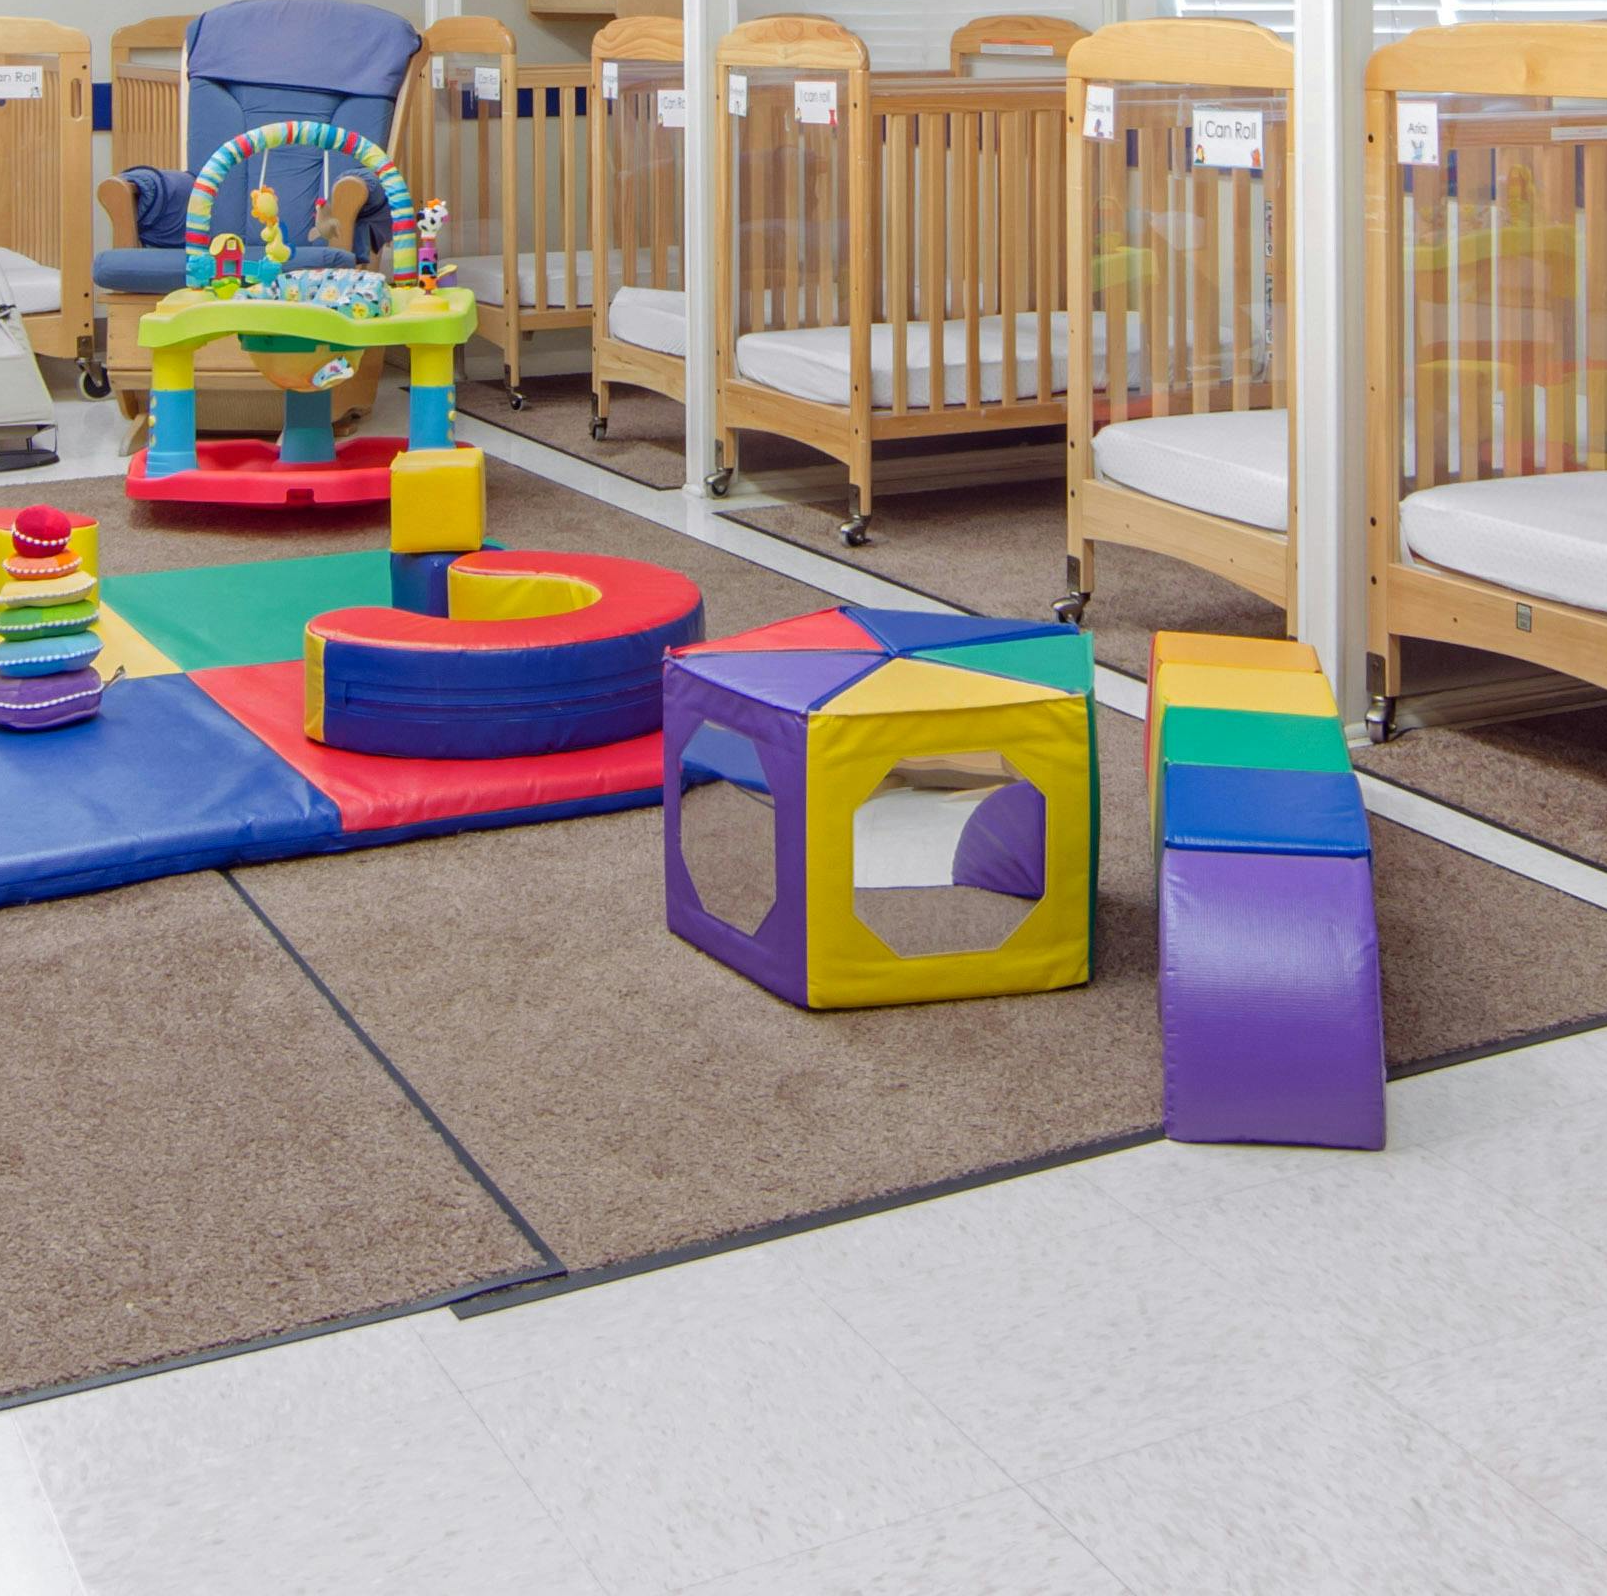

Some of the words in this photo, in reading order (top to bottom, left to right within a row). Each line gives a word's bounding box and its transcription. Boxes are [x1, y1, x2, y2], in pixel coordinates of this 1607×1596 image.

[15, 71, 37, 83] Roll
[1198, 122, 1202, 136] I
[1205, 120, 1233, 139] Can
[1235, 122, 1257, 140] Roll
